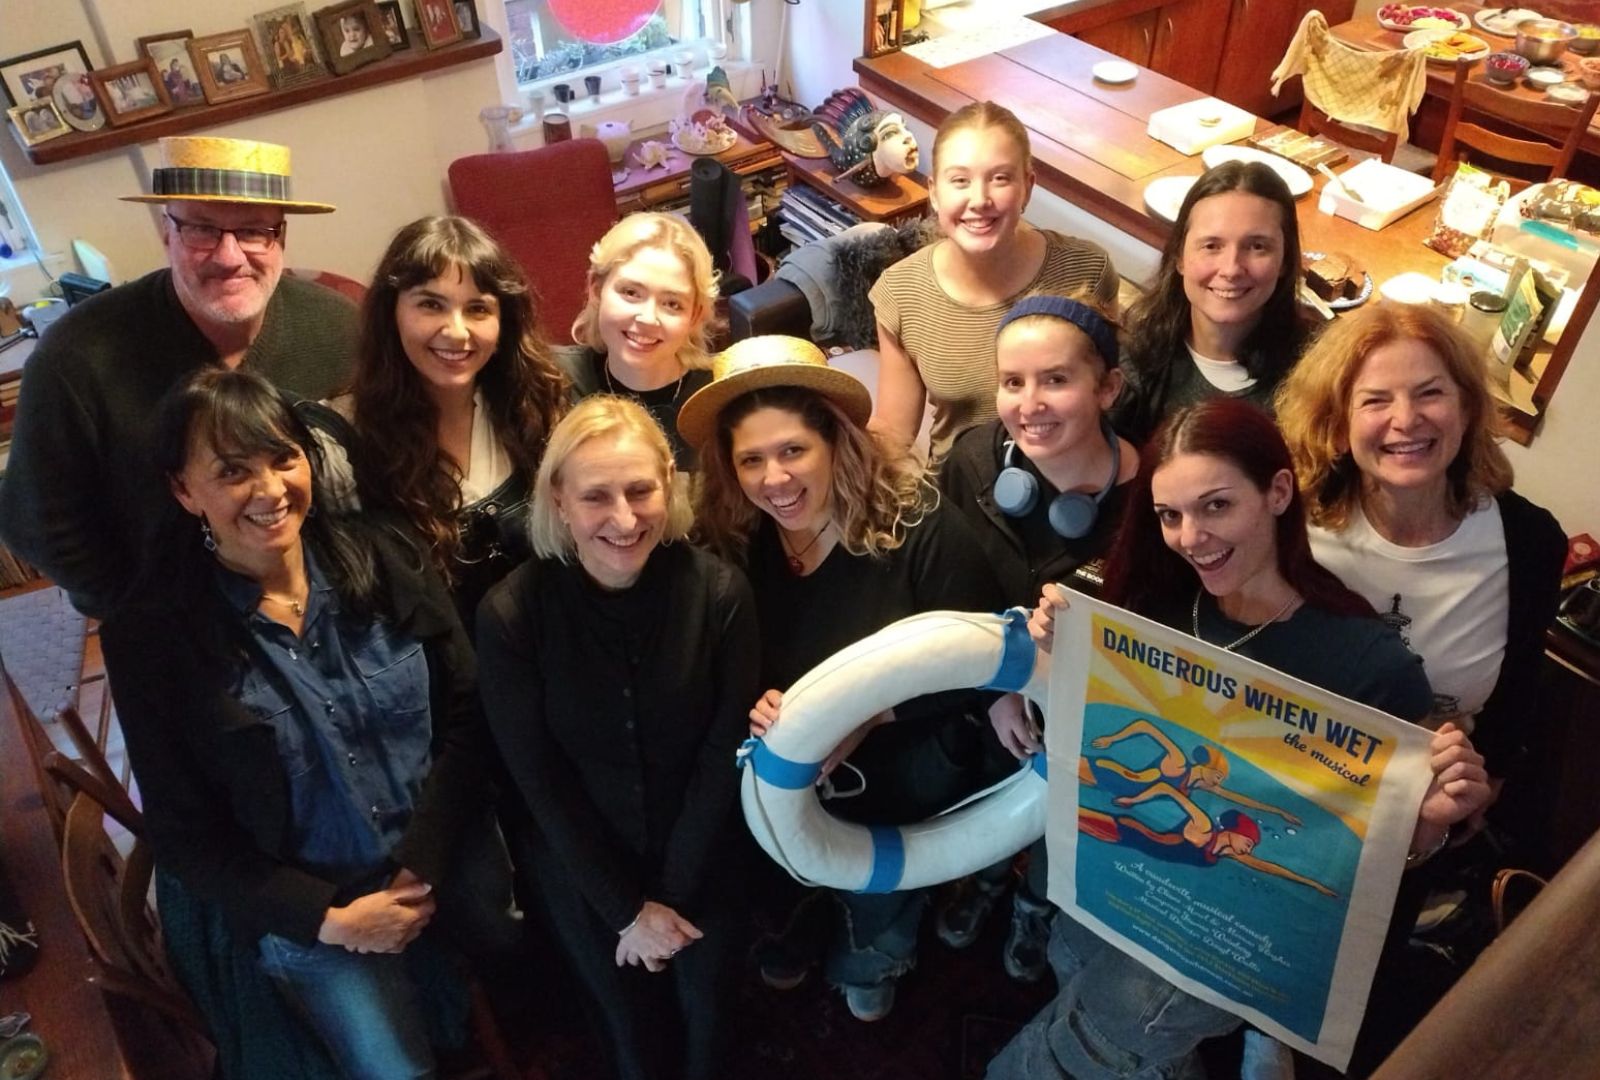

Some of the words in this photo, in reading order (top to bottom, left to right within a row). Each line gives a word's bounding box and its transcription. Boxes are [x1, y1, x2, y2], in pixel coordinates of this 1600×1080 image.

[1103, 626, 1237, 700] DANGEROUS
[1245, 684, 1318, 734] WHEN
[1325, 718, 1383, 764] WET
[1283, 732, 1307, 753] the
[1310, 749, 1370, 787] musical
[1130, 861, 1145, 872] A
[1194, 898, 1235, 923] musical
[1235, 919, 1273, 948] comedy
[1144, 879, 1156, 893] by
